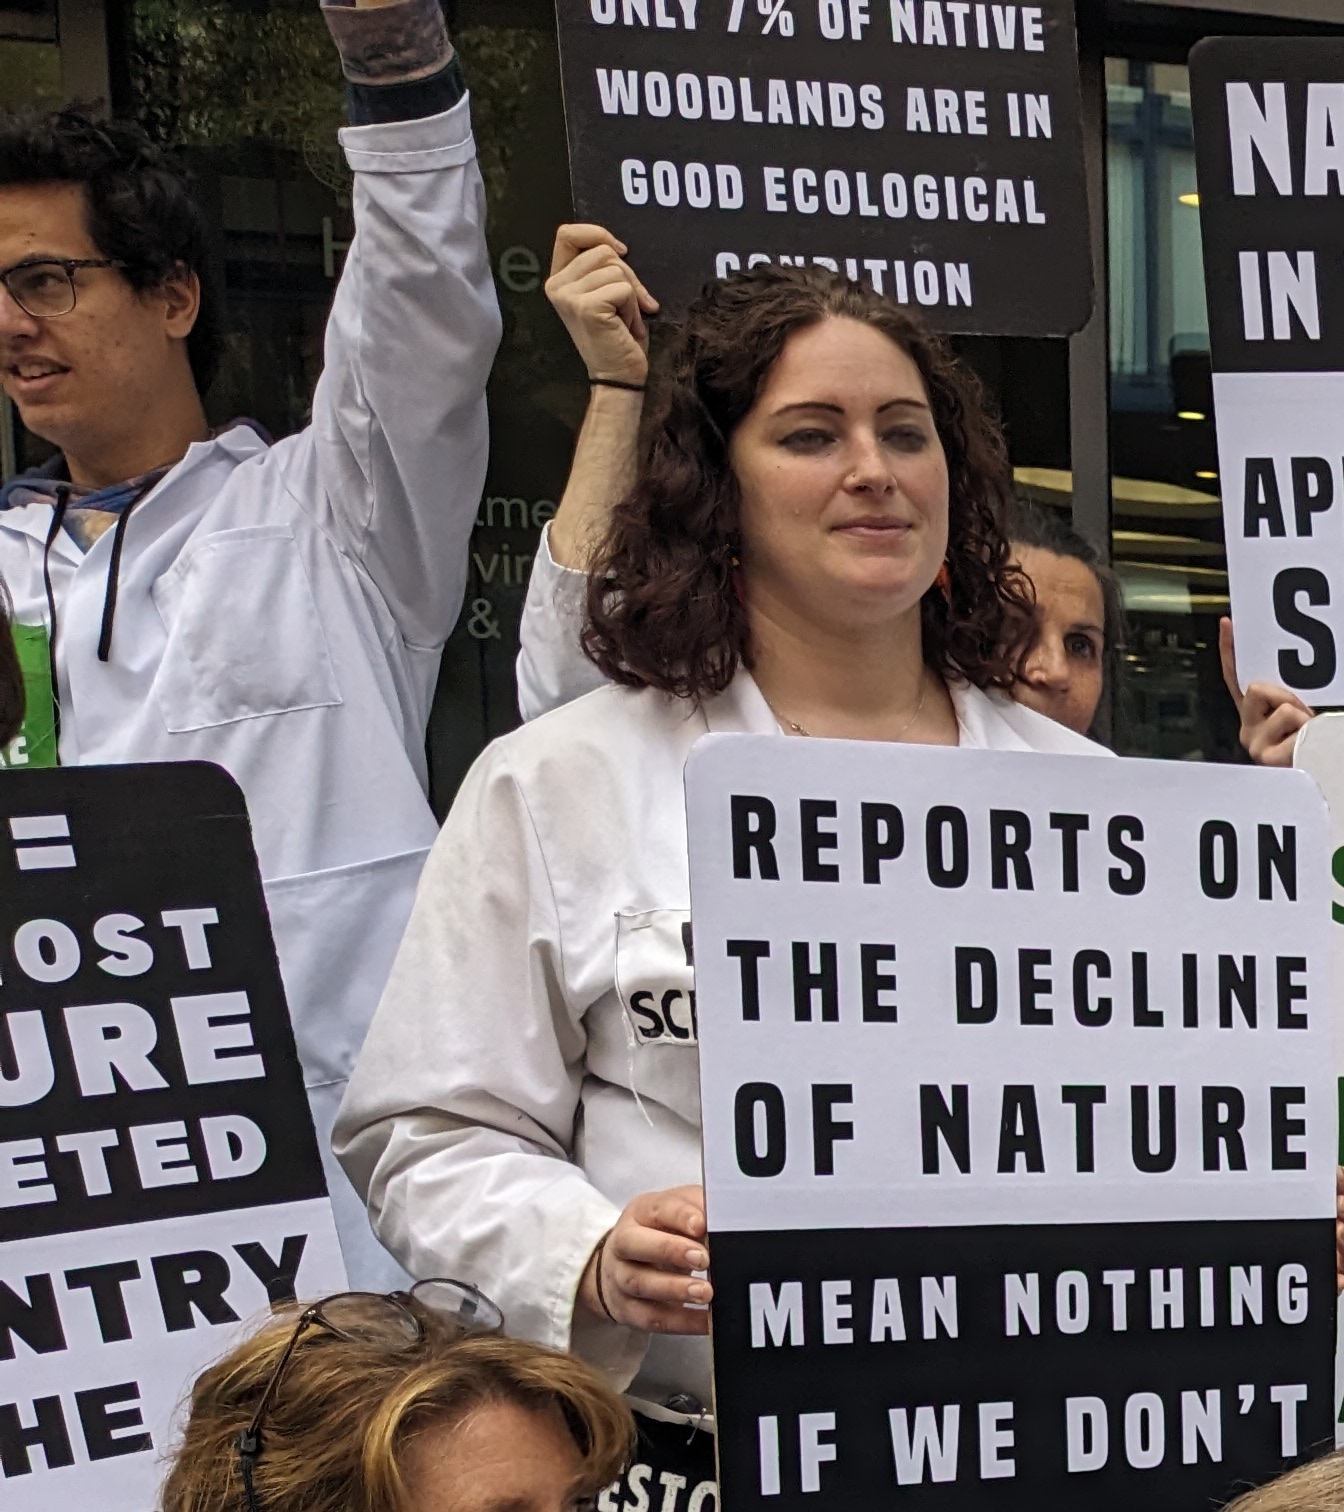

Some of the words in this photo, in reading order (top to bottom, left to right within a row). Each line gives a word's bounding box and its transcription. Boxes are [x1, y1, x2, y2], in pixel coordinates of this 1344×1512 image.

[596, 68, 884, 130] WOODLANDS
[907, 88, 988, 135] ARE
[1007, 93, 1052, 139] IN
[621, 159, 744, 209] GOOD
[764, 167, 1046, 224] ECOLOGICAL
[1238, 251, 1321, 340] IN
[468, 598, 500, 639] &
[730, 794, 1147, 894] REPORTS
[1200, 820, 1299, 902] ON
[726, 940, 897, 1023] THE
[955, 946, 1310, 1031] DECLINE
[733, 1082, 854, 1177] OF
[919, 1084, 1309, 1174] NATURE
